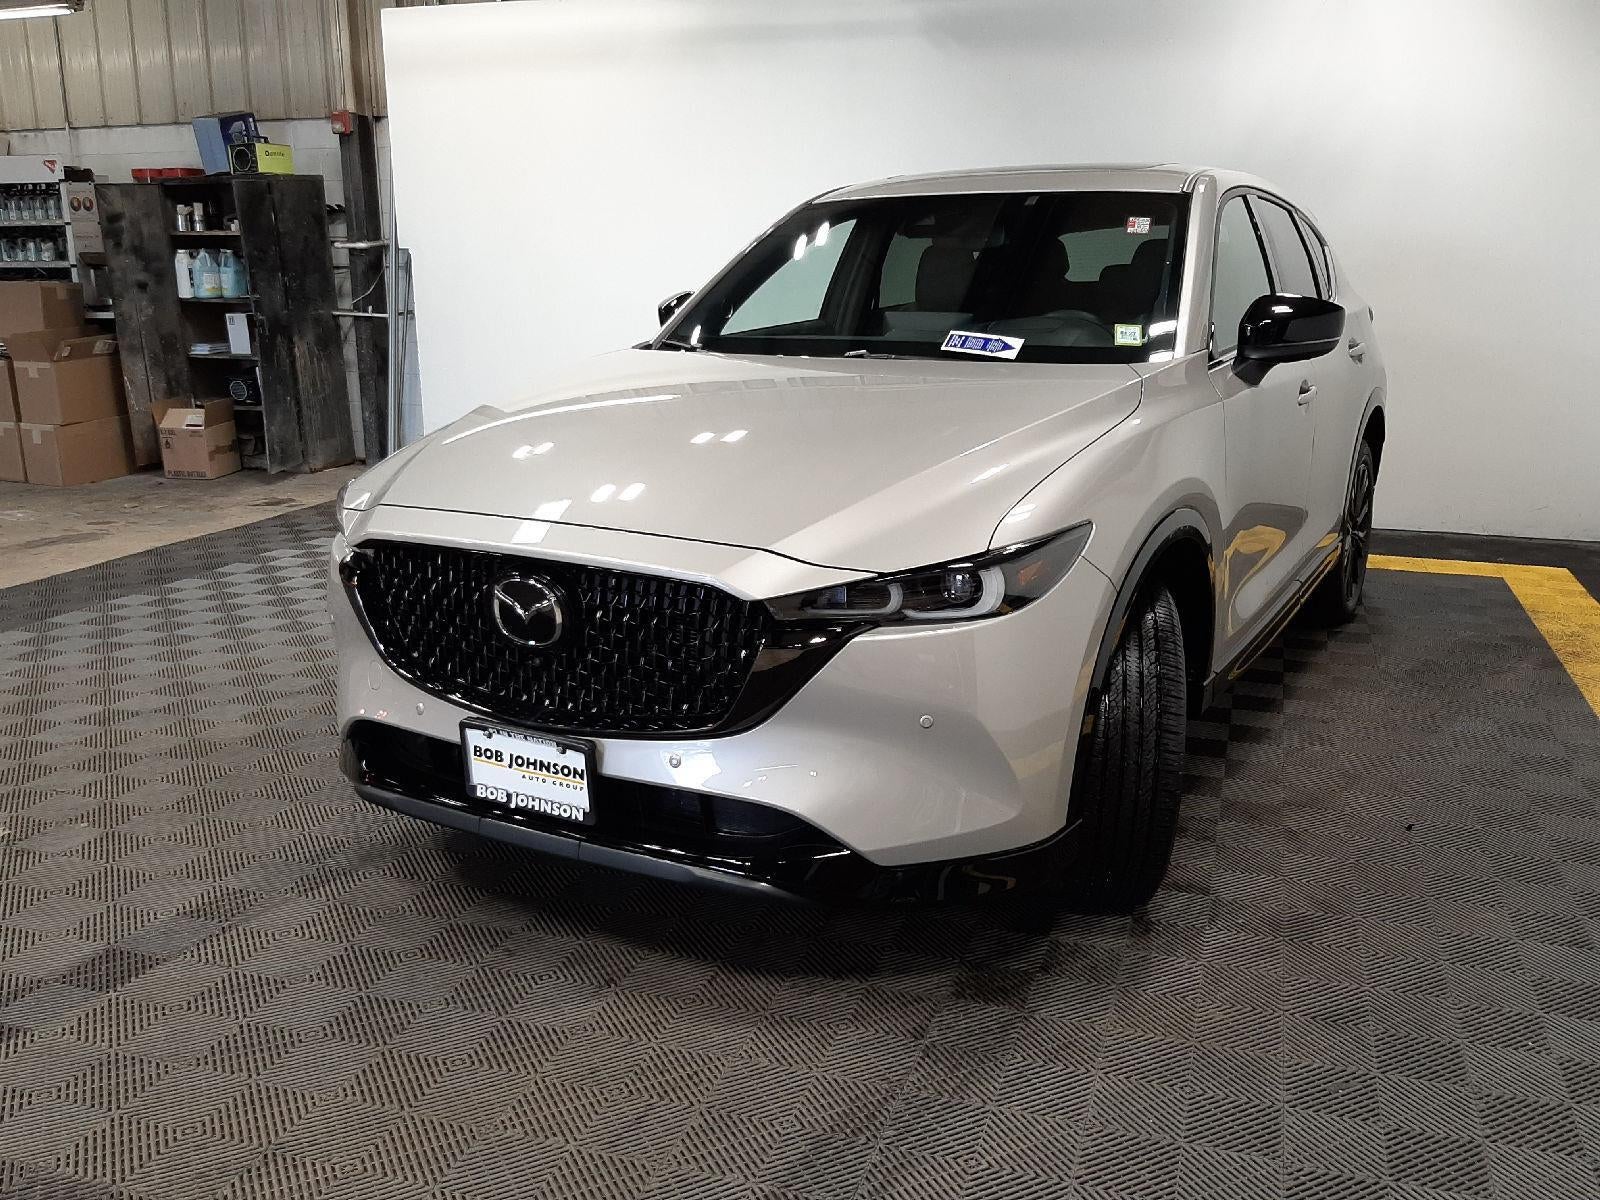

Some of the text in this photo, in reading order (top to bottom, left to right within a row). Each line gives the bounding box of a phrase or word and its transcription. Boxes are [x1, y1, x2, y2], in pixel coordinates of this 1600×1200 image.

[473, 745, 585, 781] BOB JOHNSON
[521, 774, 585, 792] AUTO GROUP
[476, 783, 584, 821] BOB JOHNSON
